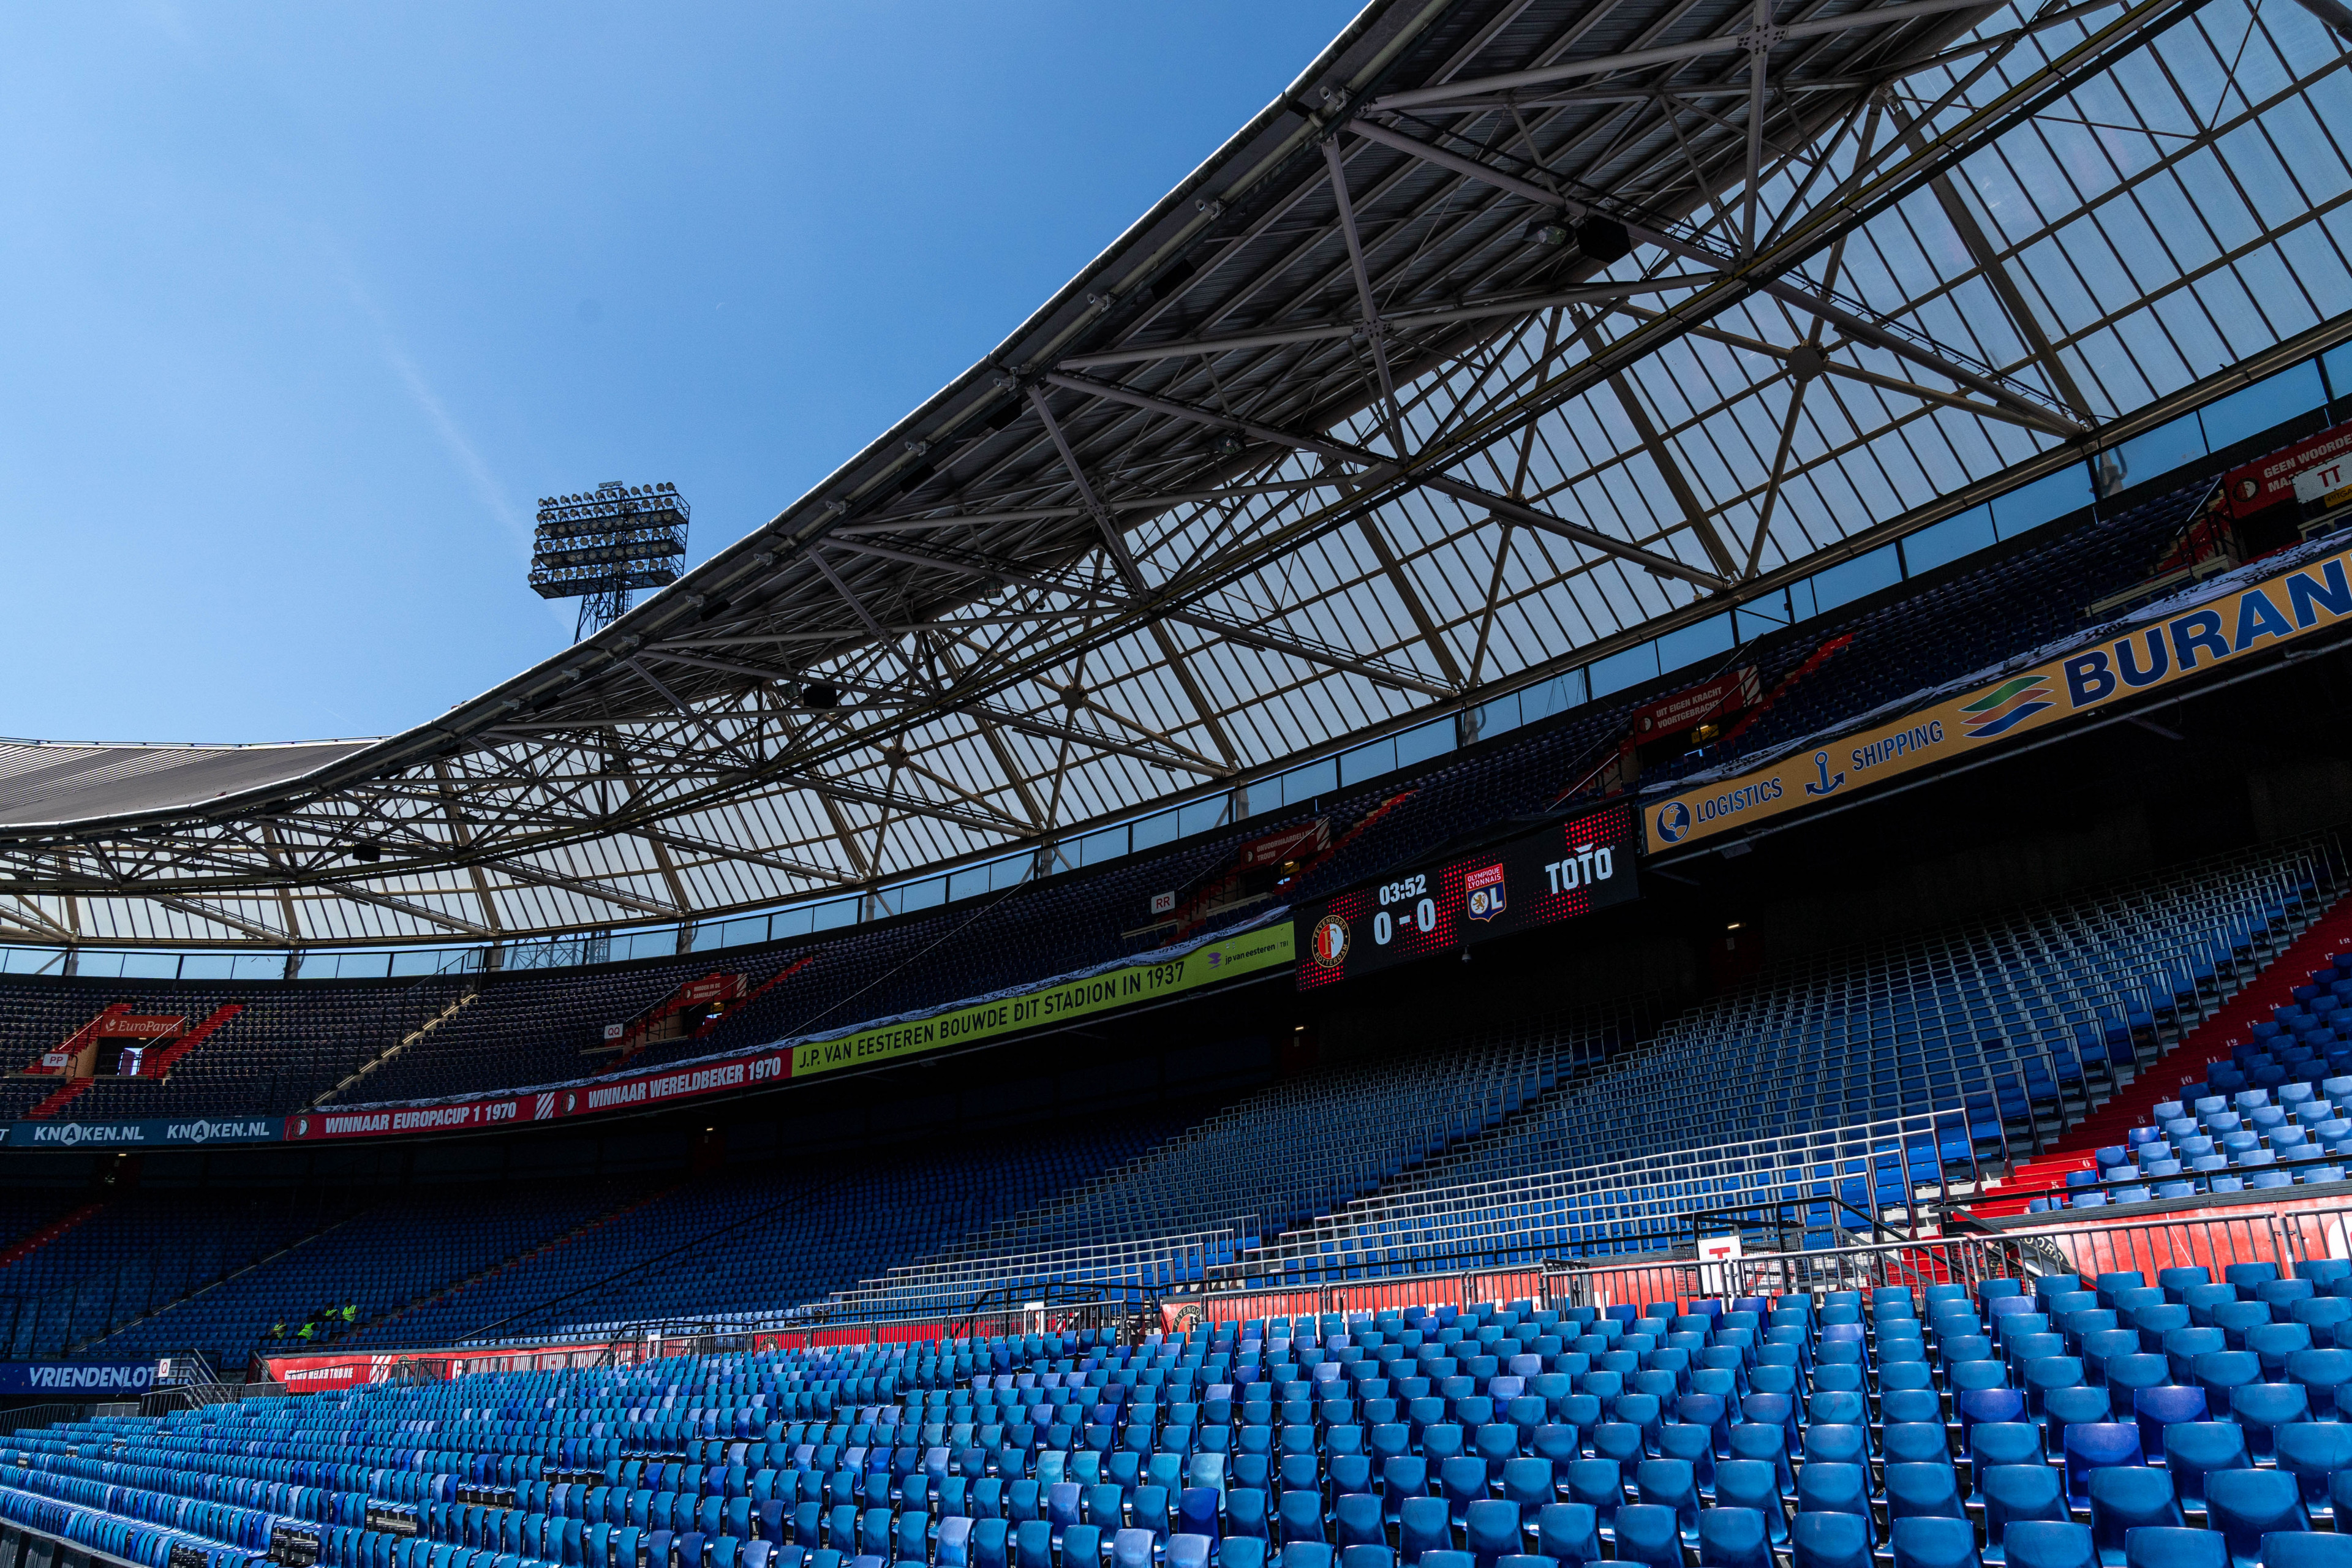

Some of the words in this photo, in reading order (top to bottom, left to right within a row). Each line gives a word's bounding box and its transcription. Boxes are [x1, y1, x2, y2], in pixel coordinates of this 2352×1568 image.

[2263, 458, 2296, 478] GEEN
[2297, 434, 2352, 464] WOORDE
[2317, 464, 2340, 488] TT
[2063, 554, 2352, 709] BURAN
[1656, 707, 1667, 718] UIT
[1670, 699, 1691, 713] EIGEN
[1692, 687, 1722, 704] KRACHT
[1657, 699, 1719, 729] VOORTGEBRACHT
[1851, 720, 1945, 772] SHIPPING
[1695, 777, 1784, 824] LOGISTICS
[1257, 851, 1276, 862] TROUW
[1467, 867, 1501, 883] OLYMPIQUE
[1545, 844, 1613, 895] TOTO
[1379, 874, 1427, 905] 03:52
[1468, 873, 1501, 889] LYONNAIS
[1156, 896, 1170, 908] RR
[1314, 917, 1347, 938] FEYENOORD
[1374, 911, 1392, 945] 0
[1417, 899, 1436, 932] 0
[1225, 955, 1232, 965] jp
[1245, 943, 1275, 958] eesteren
[1315, 943, 1348, 966] ROTTERDAM
[799, 1049, 821, 1069] J.P.
[824, 1042, 851, 1063] VAN
[858, 1023, 934, 1056] EESTEREN
[940, 1006, 1008, 1039] BOUWDE
[1014, 998, 1039, 1022] DIT
[1044, 979, 1116, 1015] STADION
[1123, 973, 1140, 995] IN
[1147, 961, 1185, 989] 1937
[118, 1020, 179, 1032] EuroParcs
[608, 1027, 620, 1036] QQ
[2225, 1038, 2239, 1047] 12
[589, 1082, 647, 1109] WINNAAR
[649, 1064, 744, 1098] WERELDBEKER
[748, 1057, 781, 1080] 1970
[2180, 1075, 2193, 1085] 10
[326, 1114, 390, 1133] WINNAAR
[393, 1107, 470, 1129] EUROPACUP
[473, 1106, 480, 1121] 1
[485, 1102, 516, 1121] 1970
[2137, 1115, 2146, 1125] 8
[34, 1125, 144, 1143] KNAKEN.NL
[167, 1121, 270, 1140] KNAKEN.NL
[2082, 1159, 2090, 1167] 6
[1174, 1306, 1200, 1327] FEYENOO
[161, 1362, 168, 1374] Q
